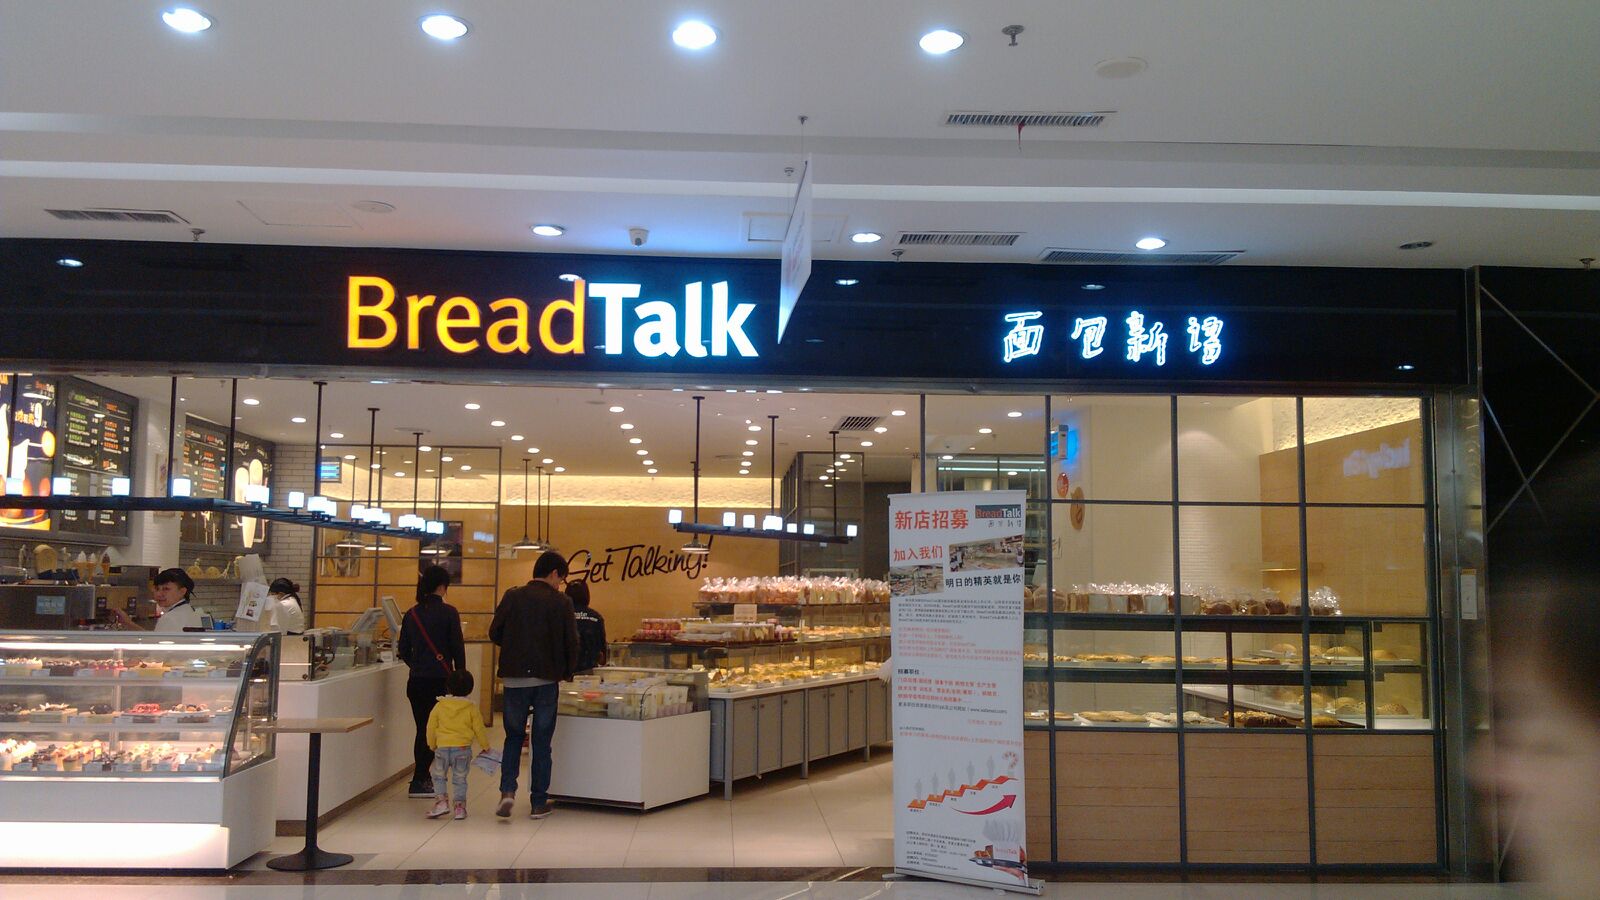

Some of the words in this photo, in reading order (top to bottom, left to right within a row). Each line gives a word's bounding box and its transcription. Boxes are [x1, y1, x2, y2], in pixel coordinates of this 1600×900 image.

[346, 274, 759, 358] BreadTalk
[894, 508, 969, 530] 新店招募
[893, 545, 943, 562] 加入我们
